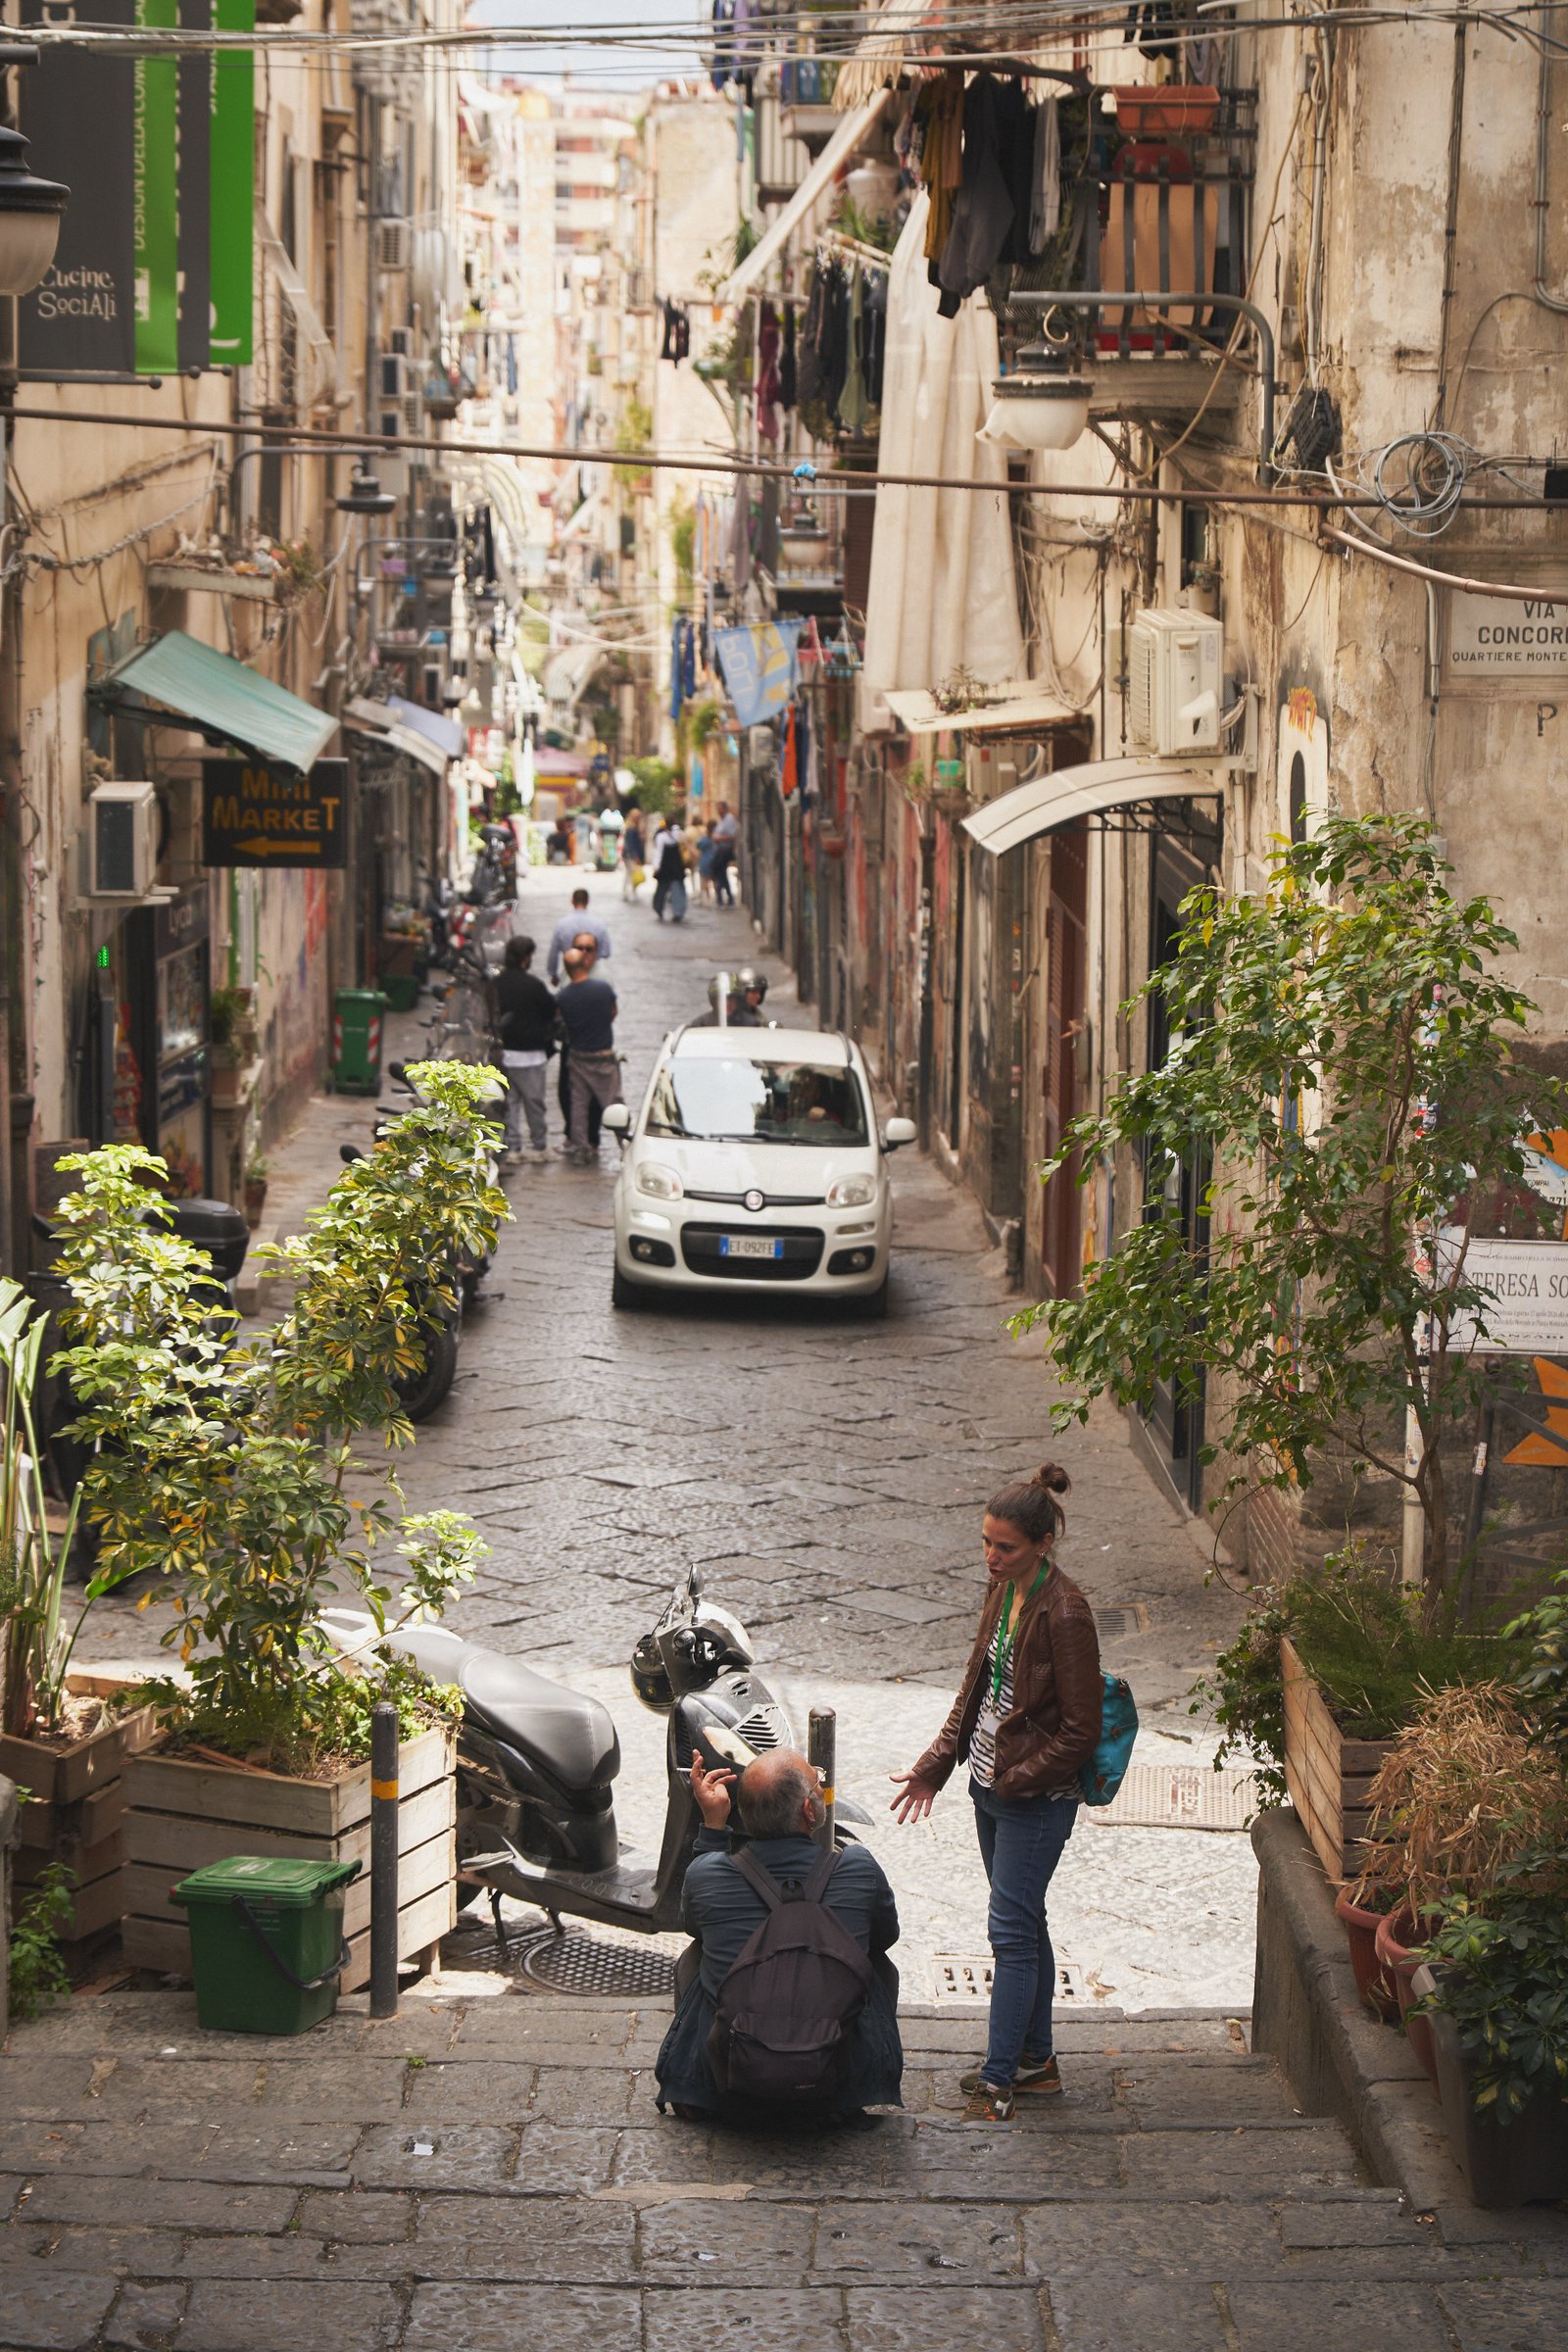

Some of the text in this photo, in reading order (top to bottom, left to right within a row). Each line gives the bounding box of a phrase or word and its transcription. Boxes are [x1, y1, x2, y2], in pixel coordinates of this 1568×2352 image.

[1524, 601, 1555, 618] VIA
[1478, 626, 1568, 644] CONCOR
[1452, 652, 1522, 662] QUARTIERE
[1472, 1272, 1540, 1297] TERESA
